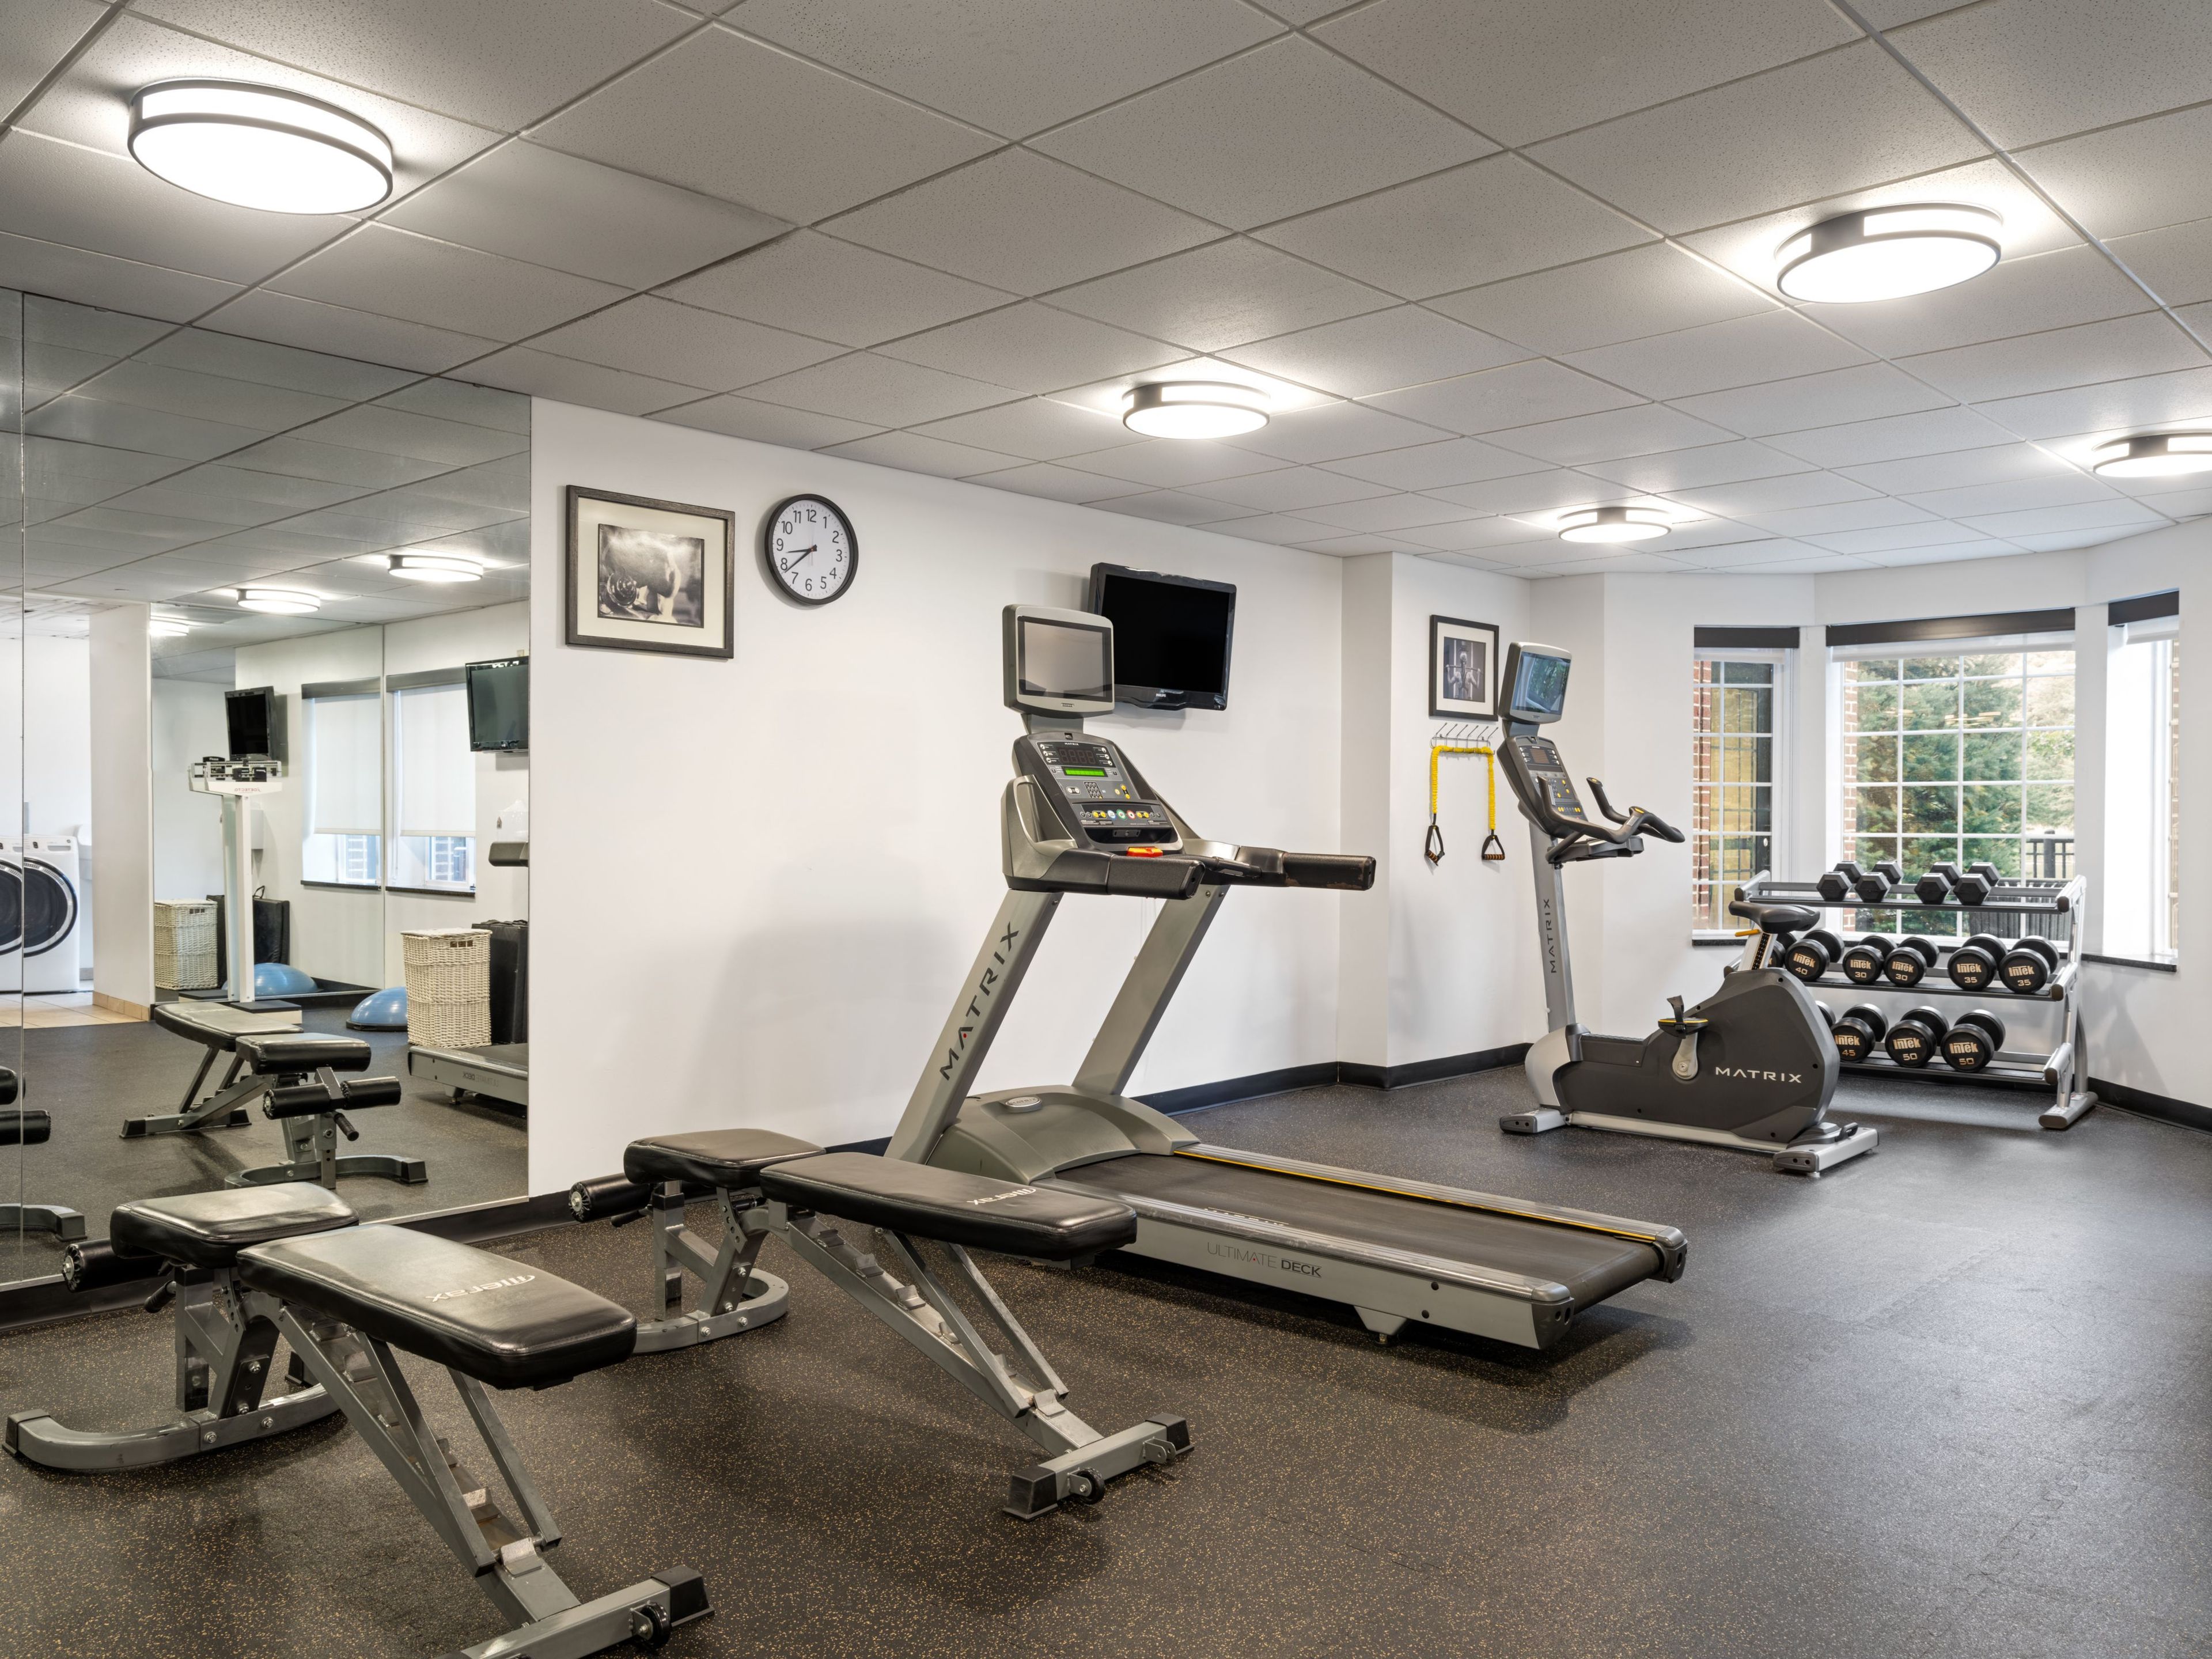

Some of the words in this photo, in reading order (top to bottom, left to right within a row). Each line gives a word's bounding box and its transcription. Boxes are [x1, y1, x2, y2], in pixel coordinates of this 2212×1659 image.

[793, 510, 801, 524] 11
[806, 509, 817, 523] 12
[823, 516, 827, 529] 1
[781, 521, 793, 535] 10
[832, 531, 839, 544] 2
[777, 538, 783, 551] 9
[836, 549, 842, 562] 3
[781, 558, 787, 571] 8
[791, 571, 798, 584] 7
[830, 567, 837, 579] 4
[805, 578, 812, 592] 6
[820, 576, 827, 589] 5
[1543, 899, 1557, 974] MATRIX
[1793, 953, 1816, 968] InTek
[1850, 959, 1872, 969] InTek
[1795, 967, 1808, 975] 40
[1892, 961, 1915, 974] InTek
[1957, 963, 1982, 973] InTek
[2009, 965, 2035, 976] InTek
[940, 921, 1020, 1081] MATRIX
[1835, 1035, 1860, 1046] InTek
[1893, 1037, 1922, 1050] InTek
[1949, 1041, 1979, 1054] InTek
[1903, 1052, 1918, 1061] 50
[1715, 1067, 1802, 1084] MATRIX
[1207, 1242, 1277, 1269] ULTIMATE
[1281, 1259, 1322, 1277] DECK
